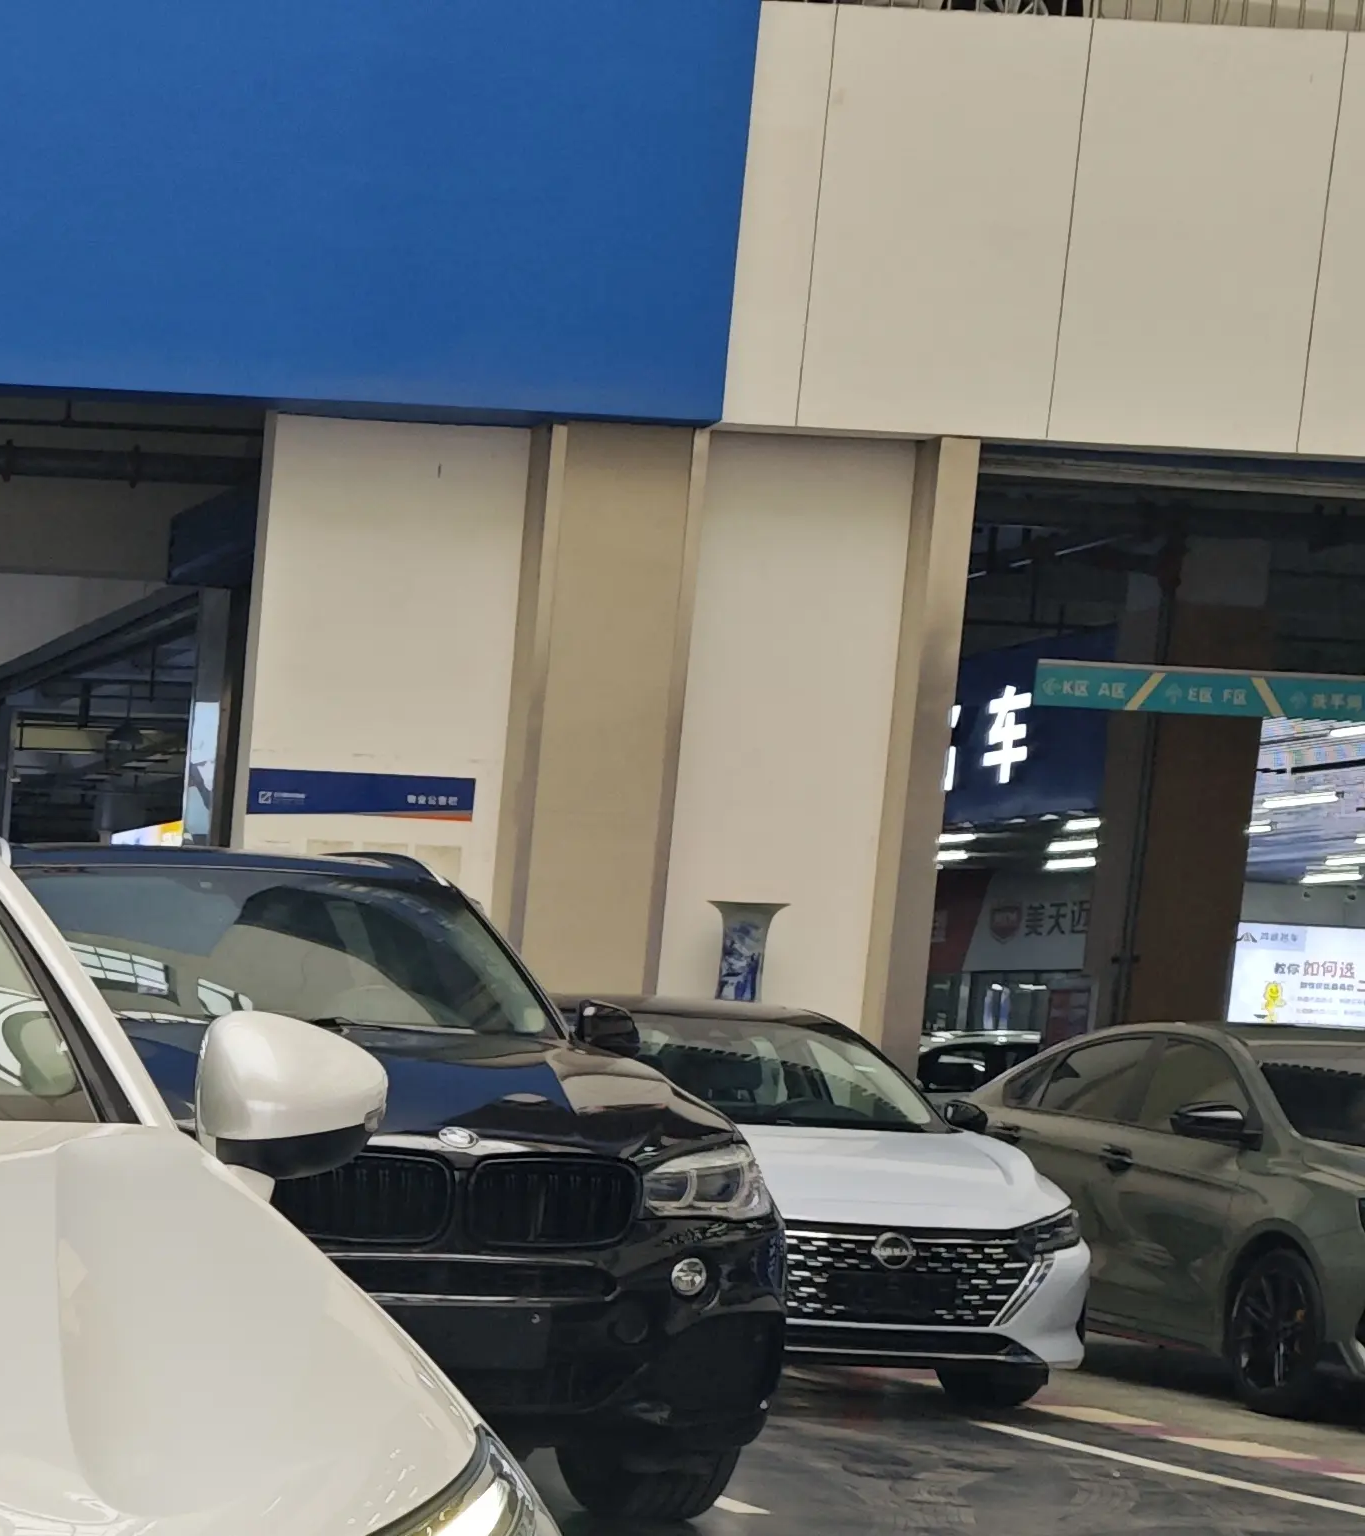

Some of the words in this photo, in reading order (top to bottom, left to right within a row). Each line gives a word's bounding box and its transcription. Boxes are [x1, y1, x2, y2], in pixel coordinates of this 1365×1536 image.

[1062, 679, 1090, 698] K区
[1098, 682, 1127, 699] A区
[1188, 686, 1213, 703] E区
[1222, 688, 1248, 705] F区
